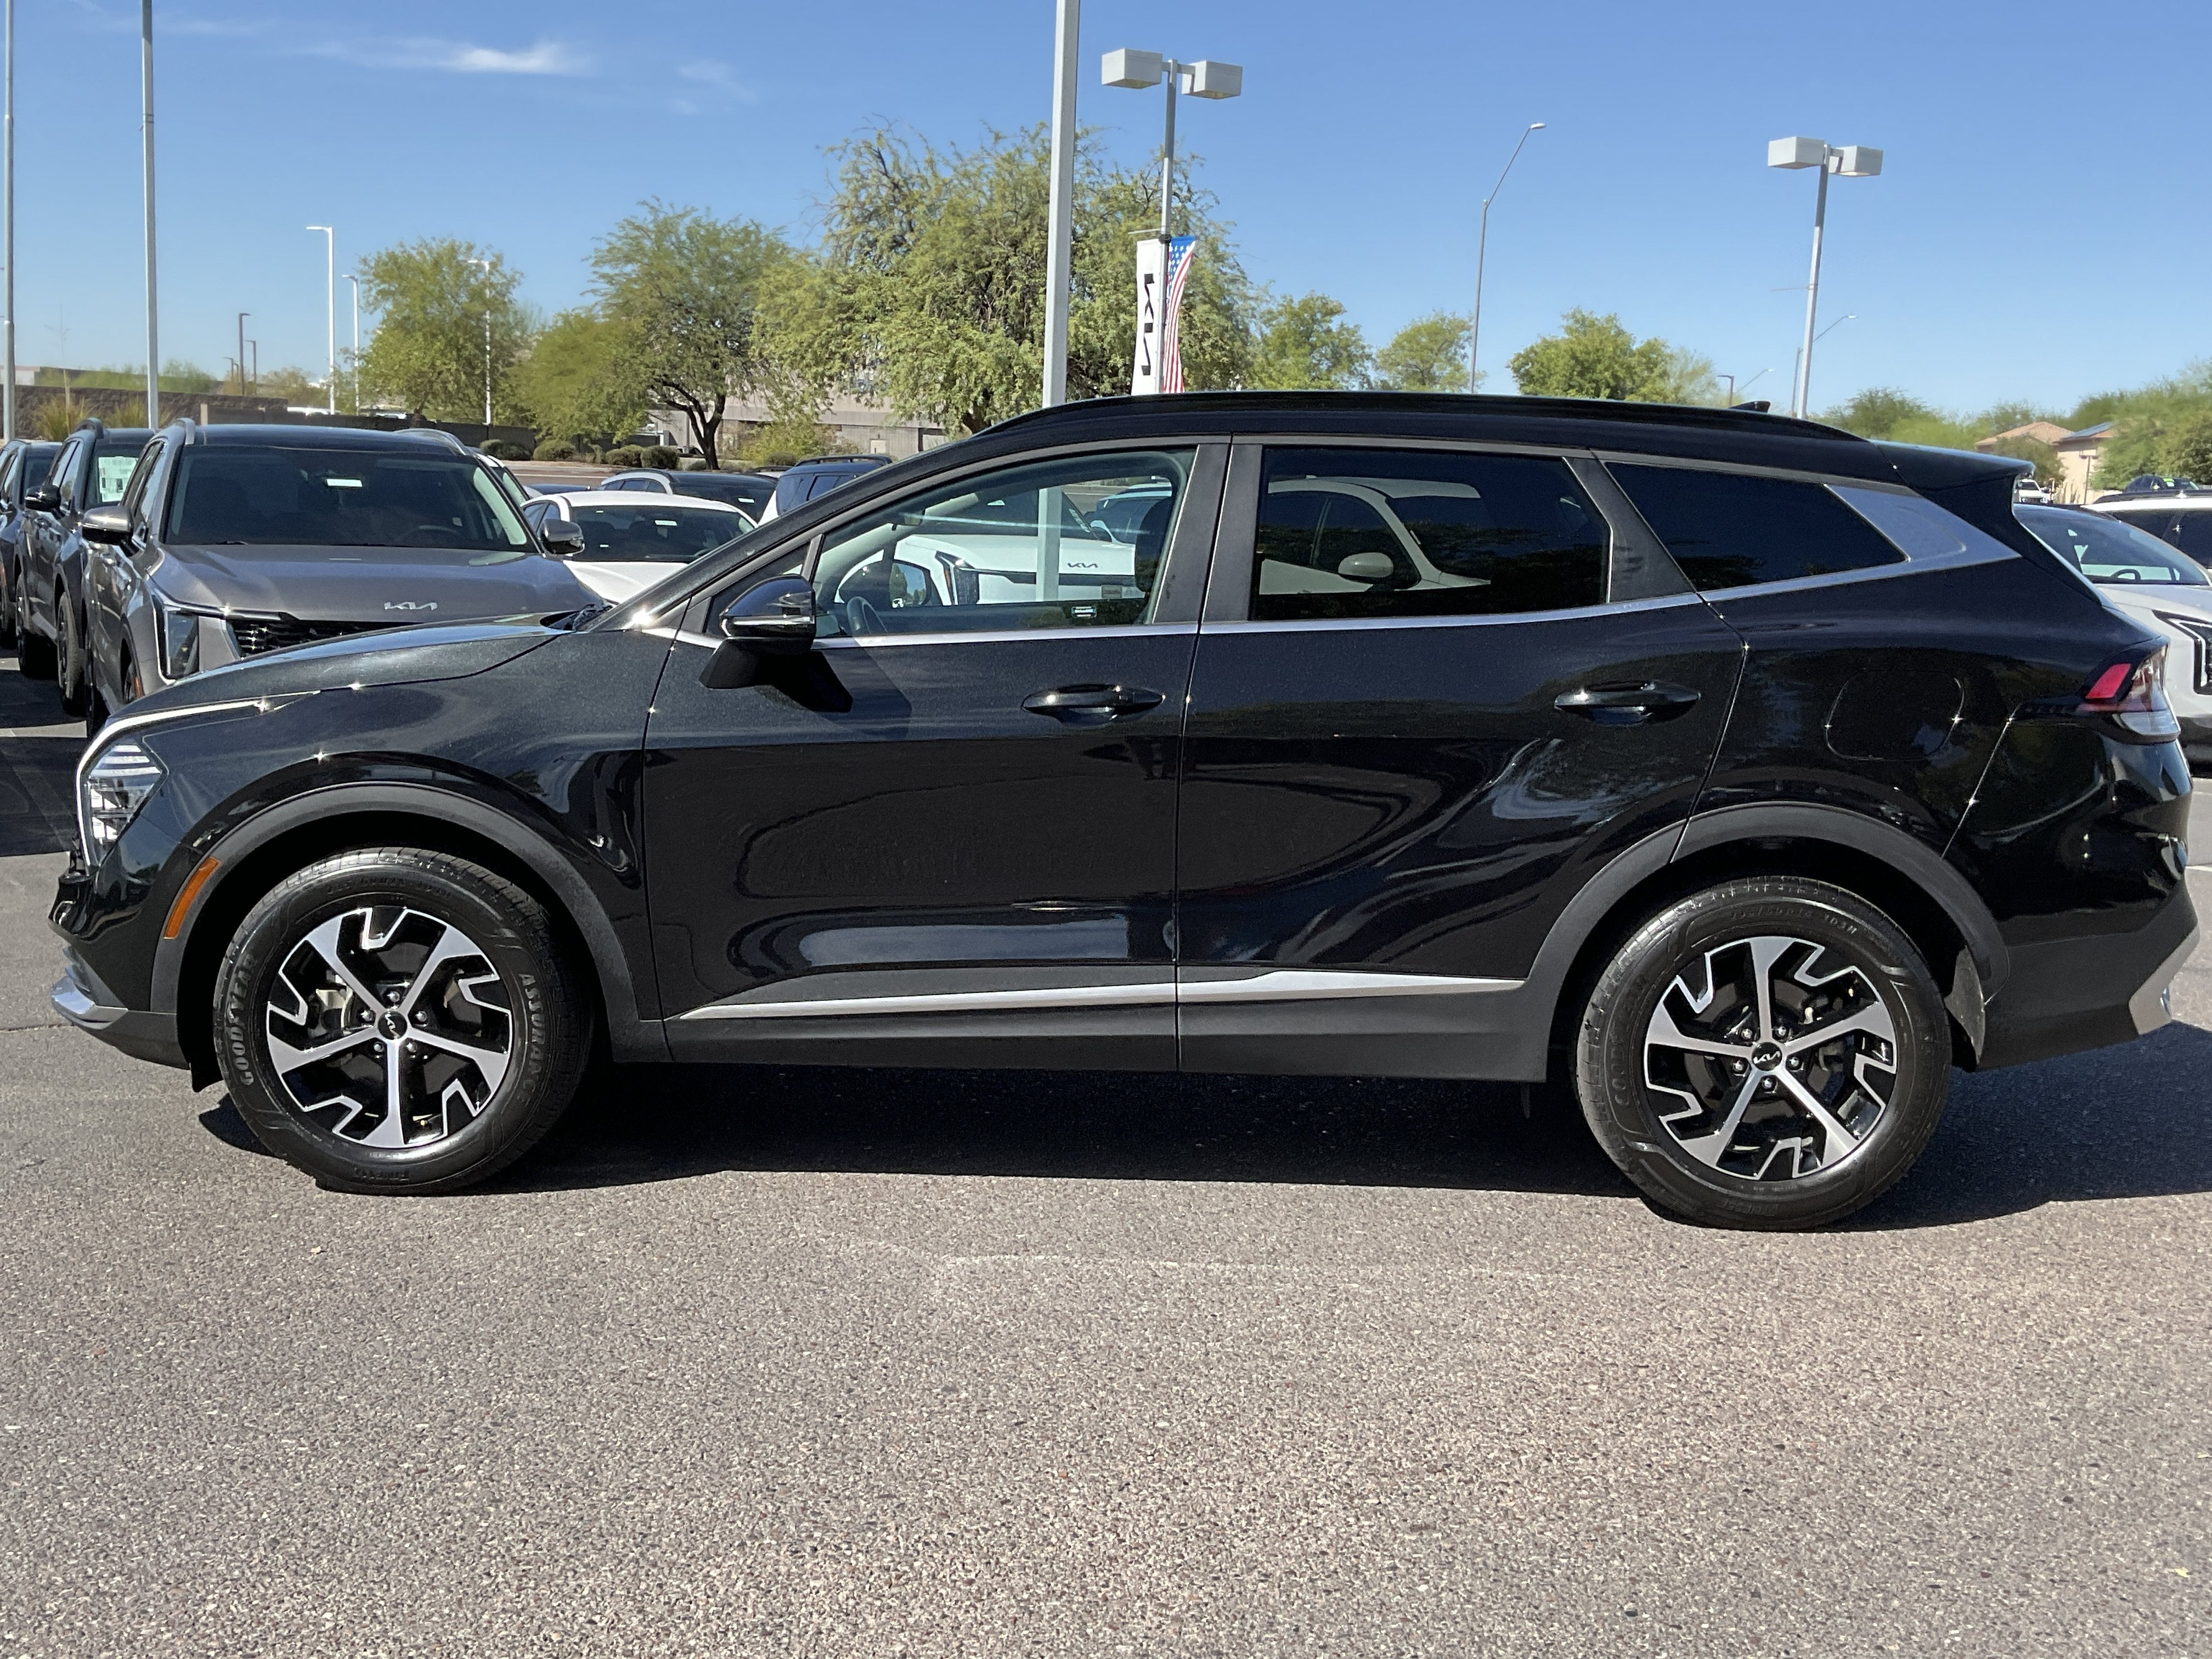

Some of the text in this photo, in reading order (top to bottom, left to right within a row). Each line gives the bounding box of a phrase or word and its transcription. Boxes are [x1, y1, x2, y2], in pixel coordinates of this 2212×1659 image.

[1141, 273, 1154, 376] KIA
[384, 601, 438, 611] KIA
[227, 952, 256, 1086] GOODYEAR
[517, 974, 545, 1107] ASSURANCE
[1753, 1051, 1781, 1064] KIA
